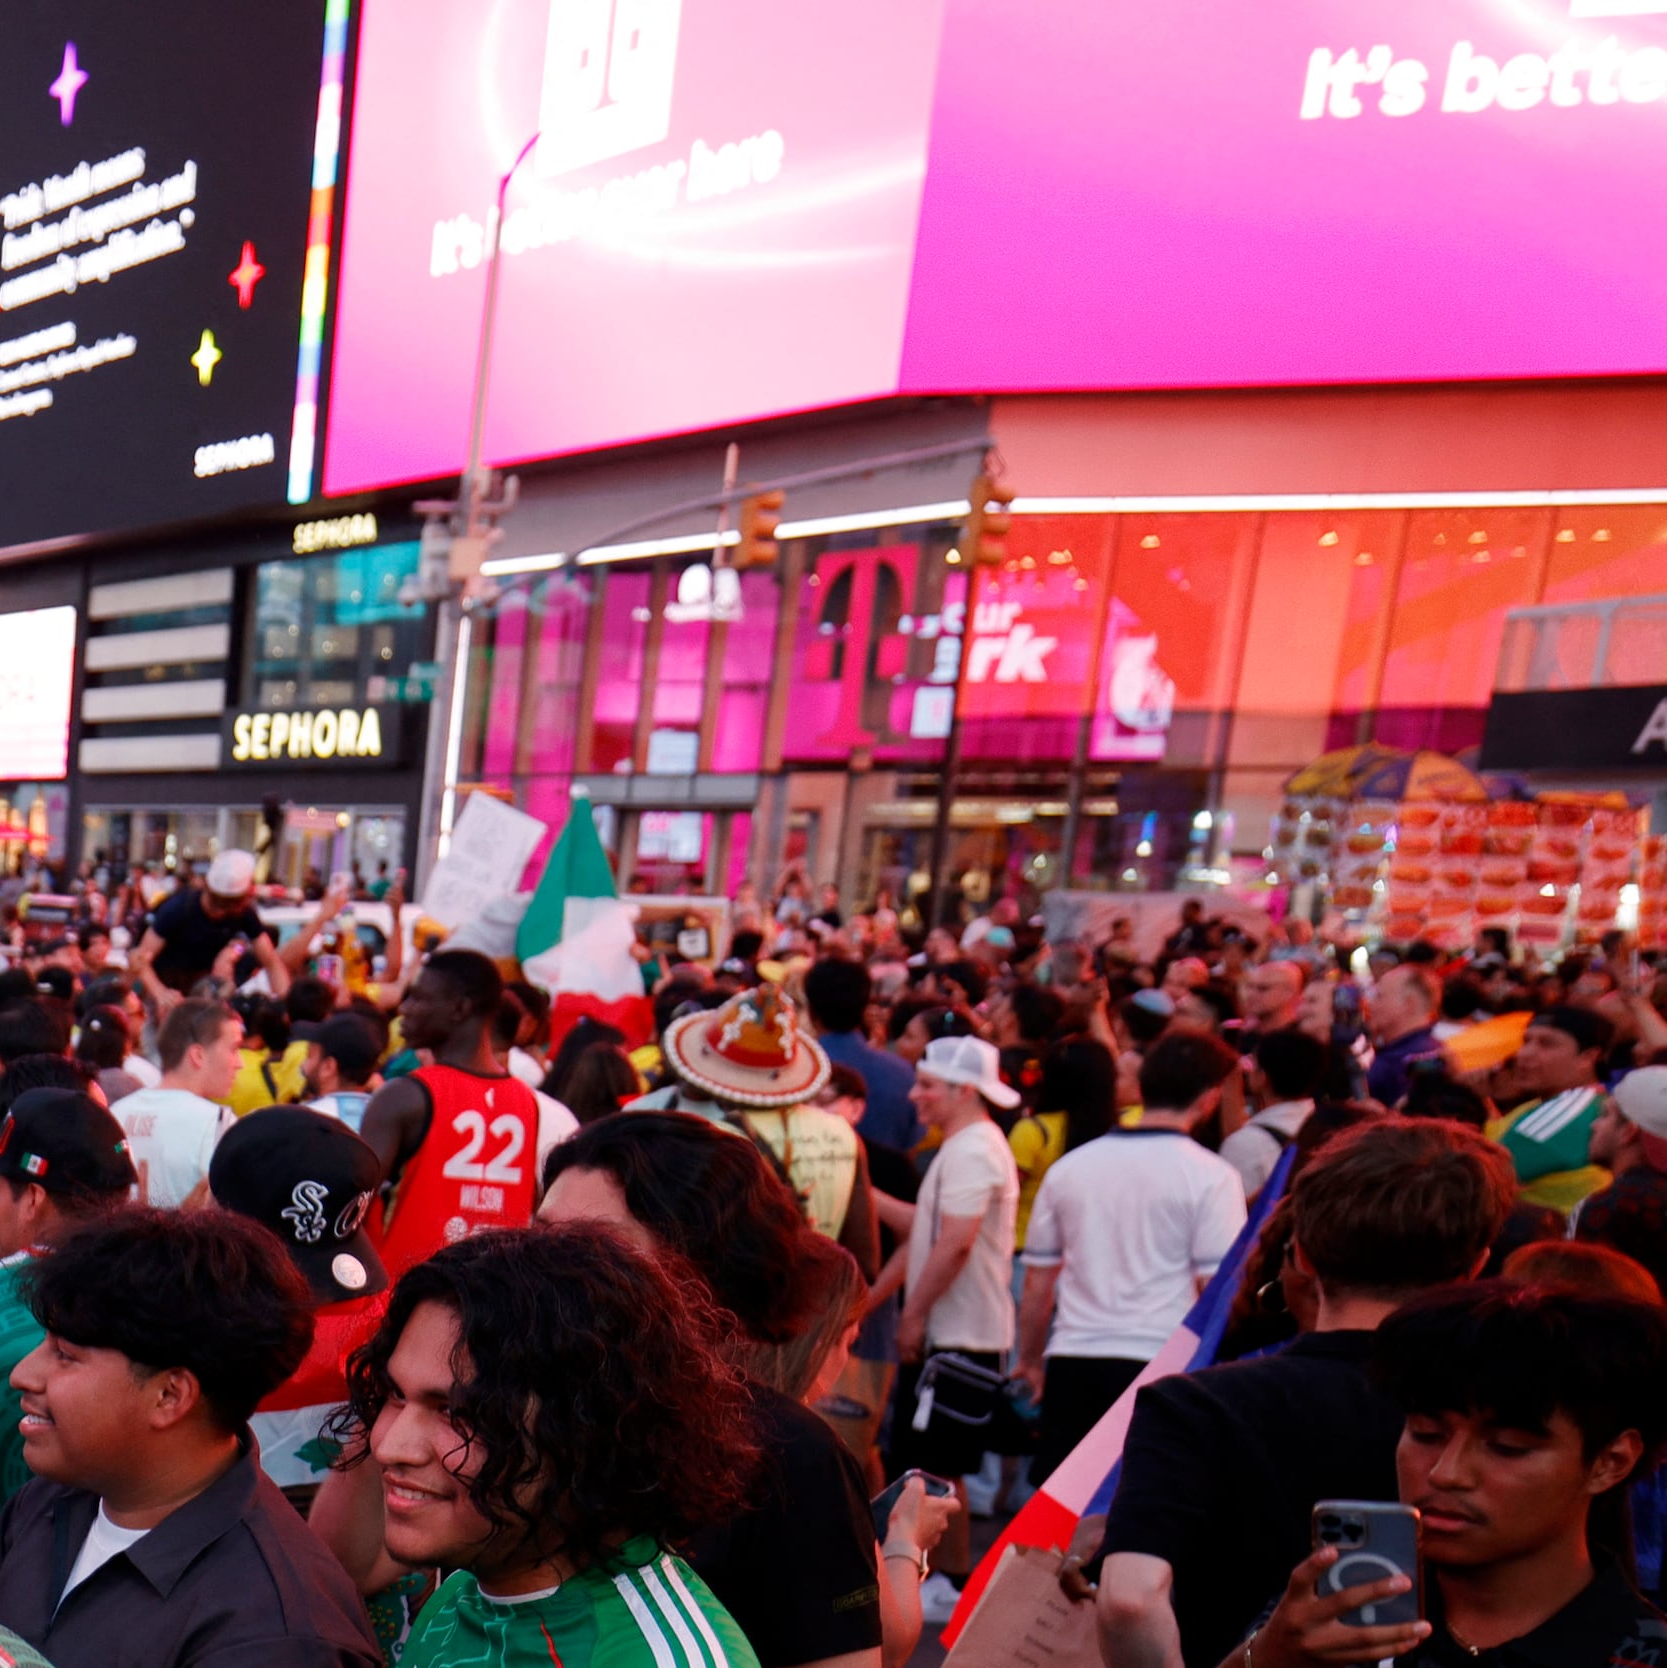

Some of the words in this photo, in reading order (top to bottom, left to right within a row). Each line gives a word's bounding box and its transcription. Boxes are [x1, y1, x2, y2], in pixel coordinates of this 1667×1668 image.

[1301, 45, 1429, 120] It's
[292, 513, 377, 554] SEPHORA
[232, 707, 382, 762] SEPHORA
[442, 1109, 525, 1185] 22
